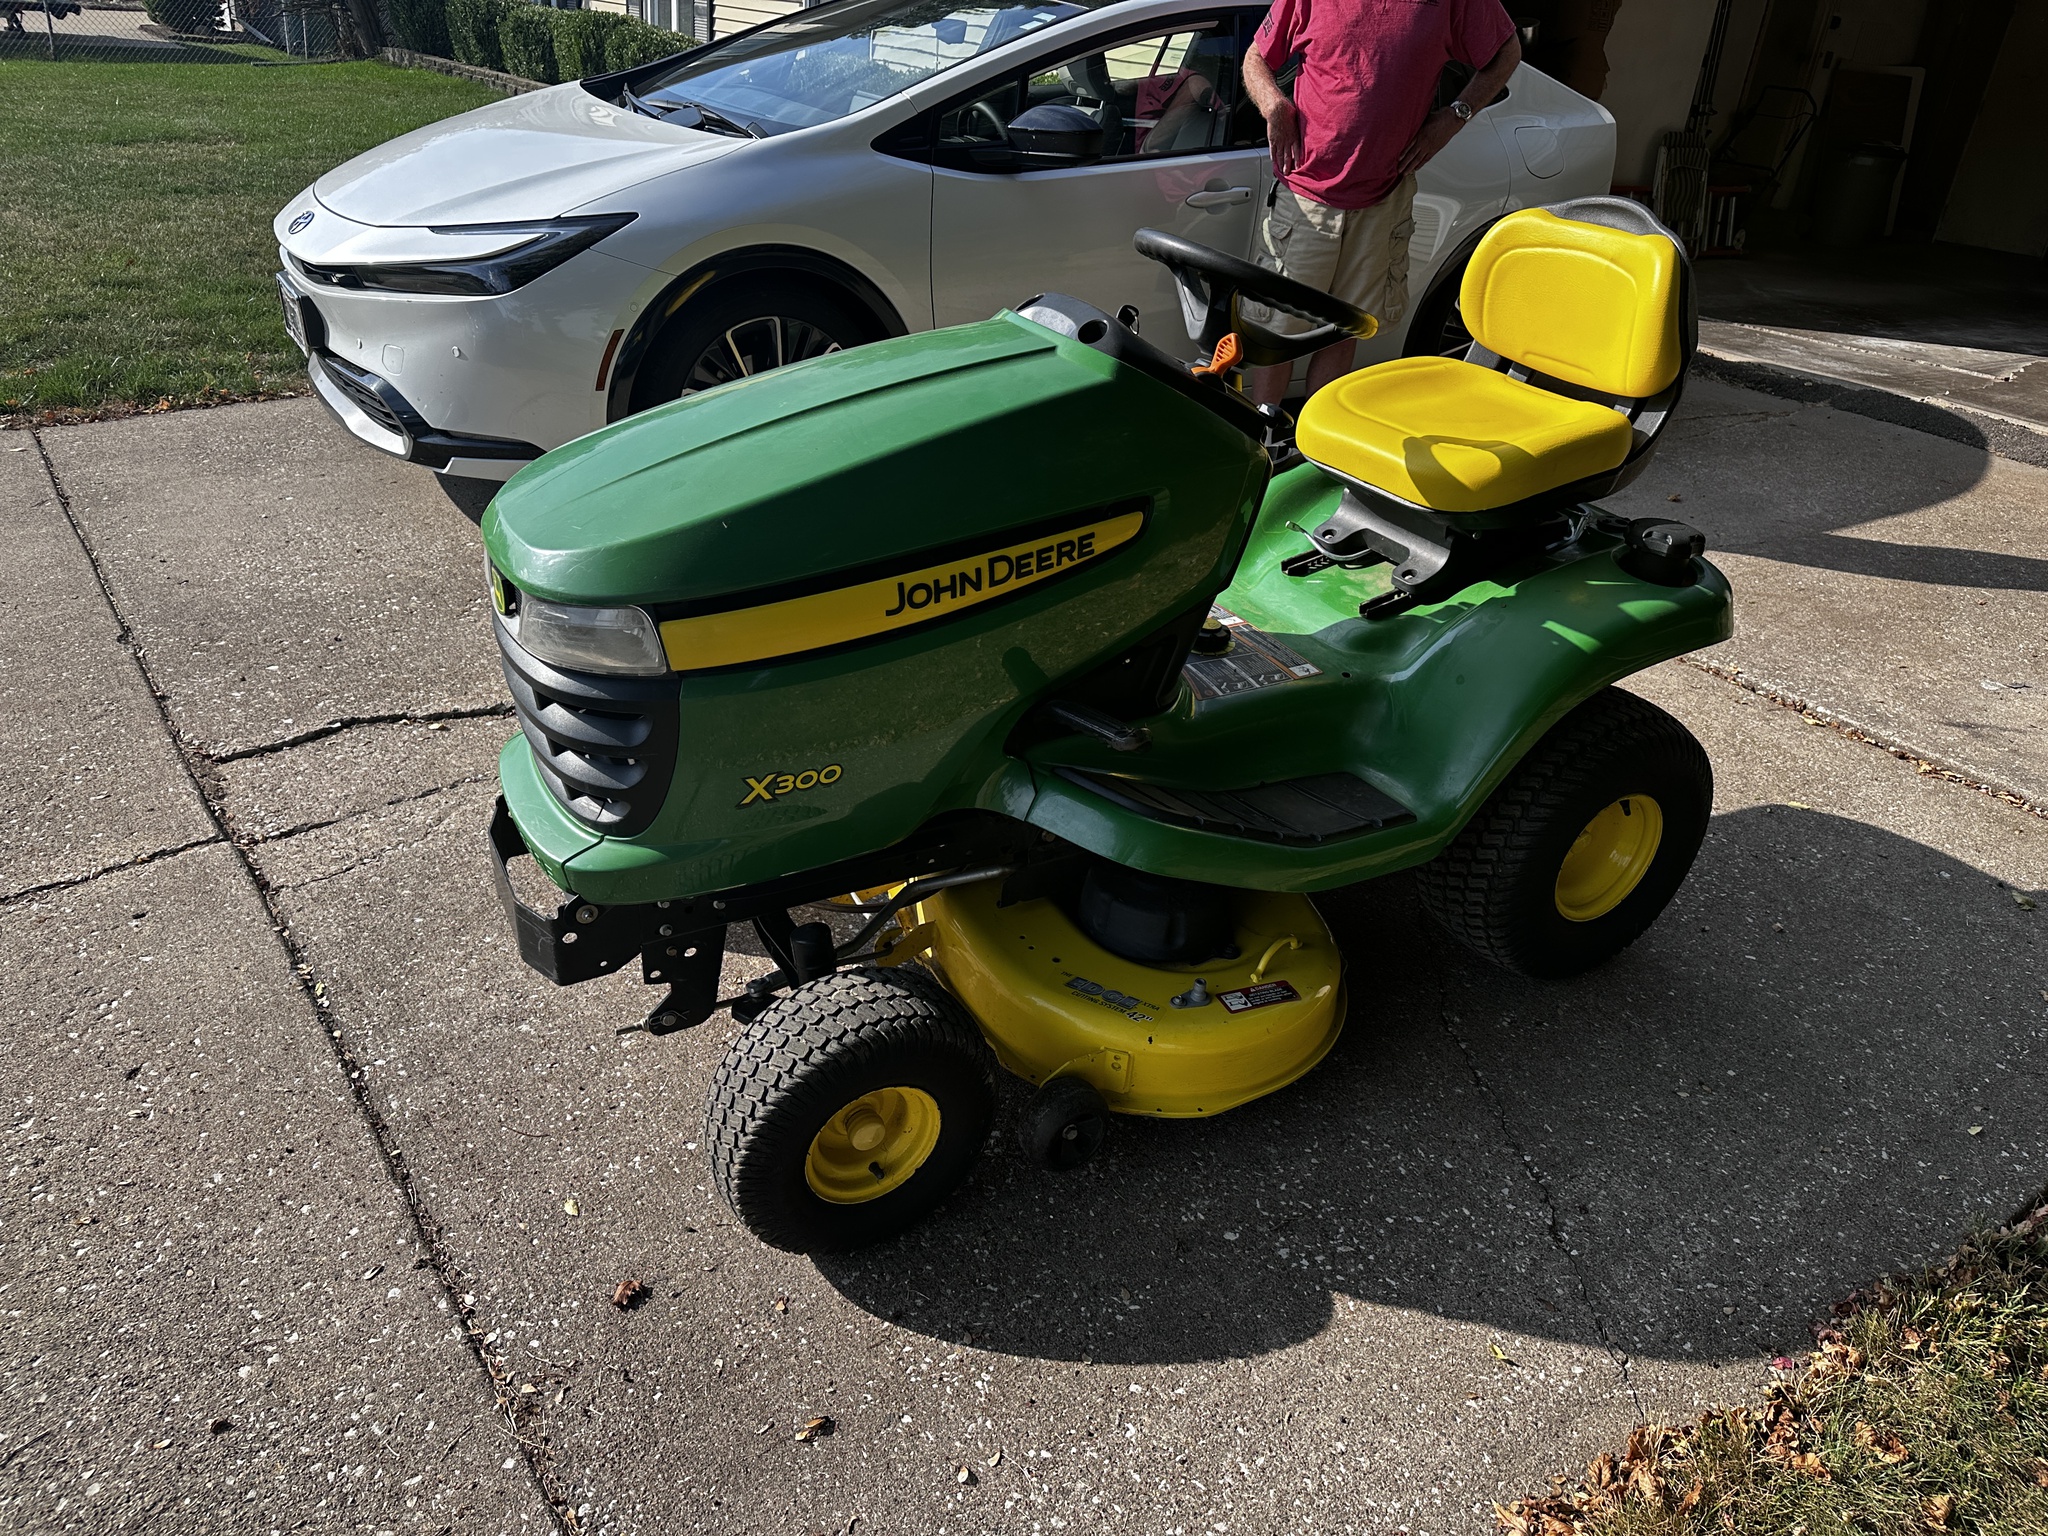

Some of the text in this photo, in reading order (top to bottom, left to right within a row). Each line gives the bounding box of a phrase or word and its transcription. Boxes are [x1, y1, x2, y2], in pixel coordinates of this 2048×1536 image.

[885, 532, 1095, 616] JOHN DEERE
[737, 763, 844, 807] X300
[1064, 976, 1142, 1010] EDGE
[1071, 990, 1155, 1023] CUTTING SYSTEM 42"
[1142, 1001, 1160, 1011] XTRA
